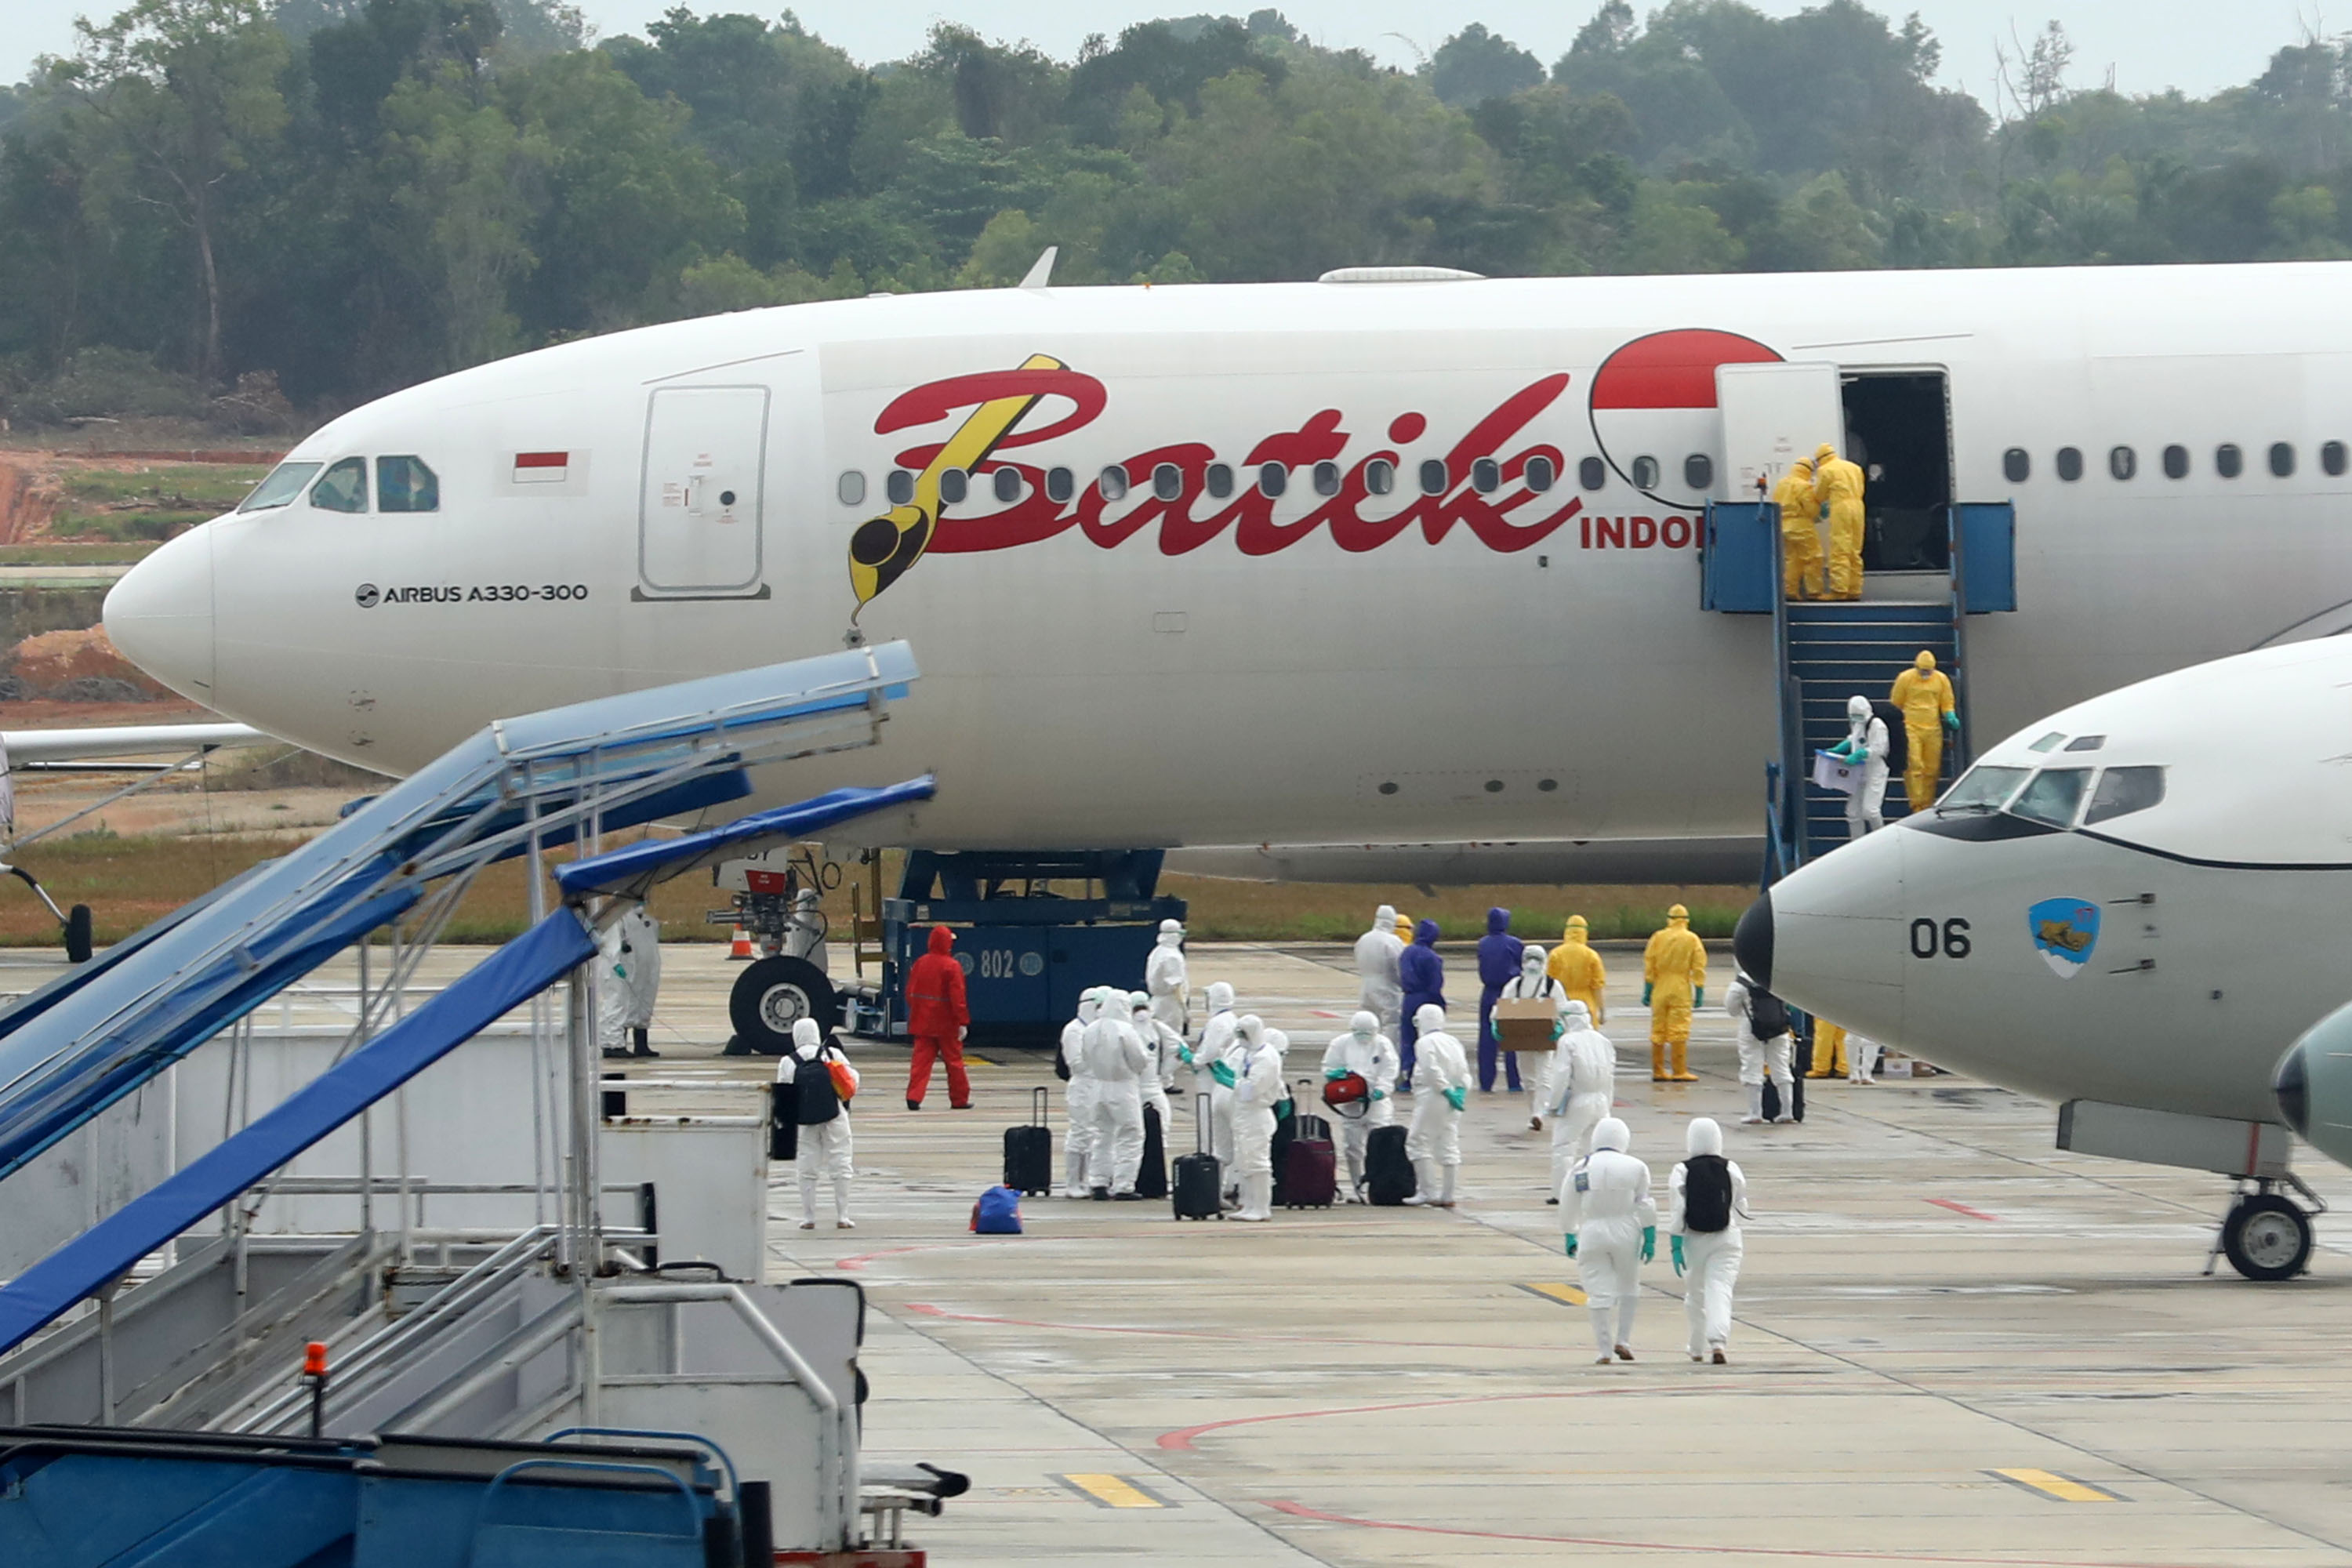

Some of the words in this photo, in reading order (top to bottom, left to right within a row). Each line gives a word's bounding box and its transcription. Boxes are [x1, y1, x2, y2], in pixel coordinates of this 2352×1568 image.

[875, 368, 1582, 555] Batik
[383, 586, 463, 603] AIRBUS
[466, 584, 589, 602] A330-300
[1910, 917, 1972, 959] 06
[981, 949, 1014, 978] 802
